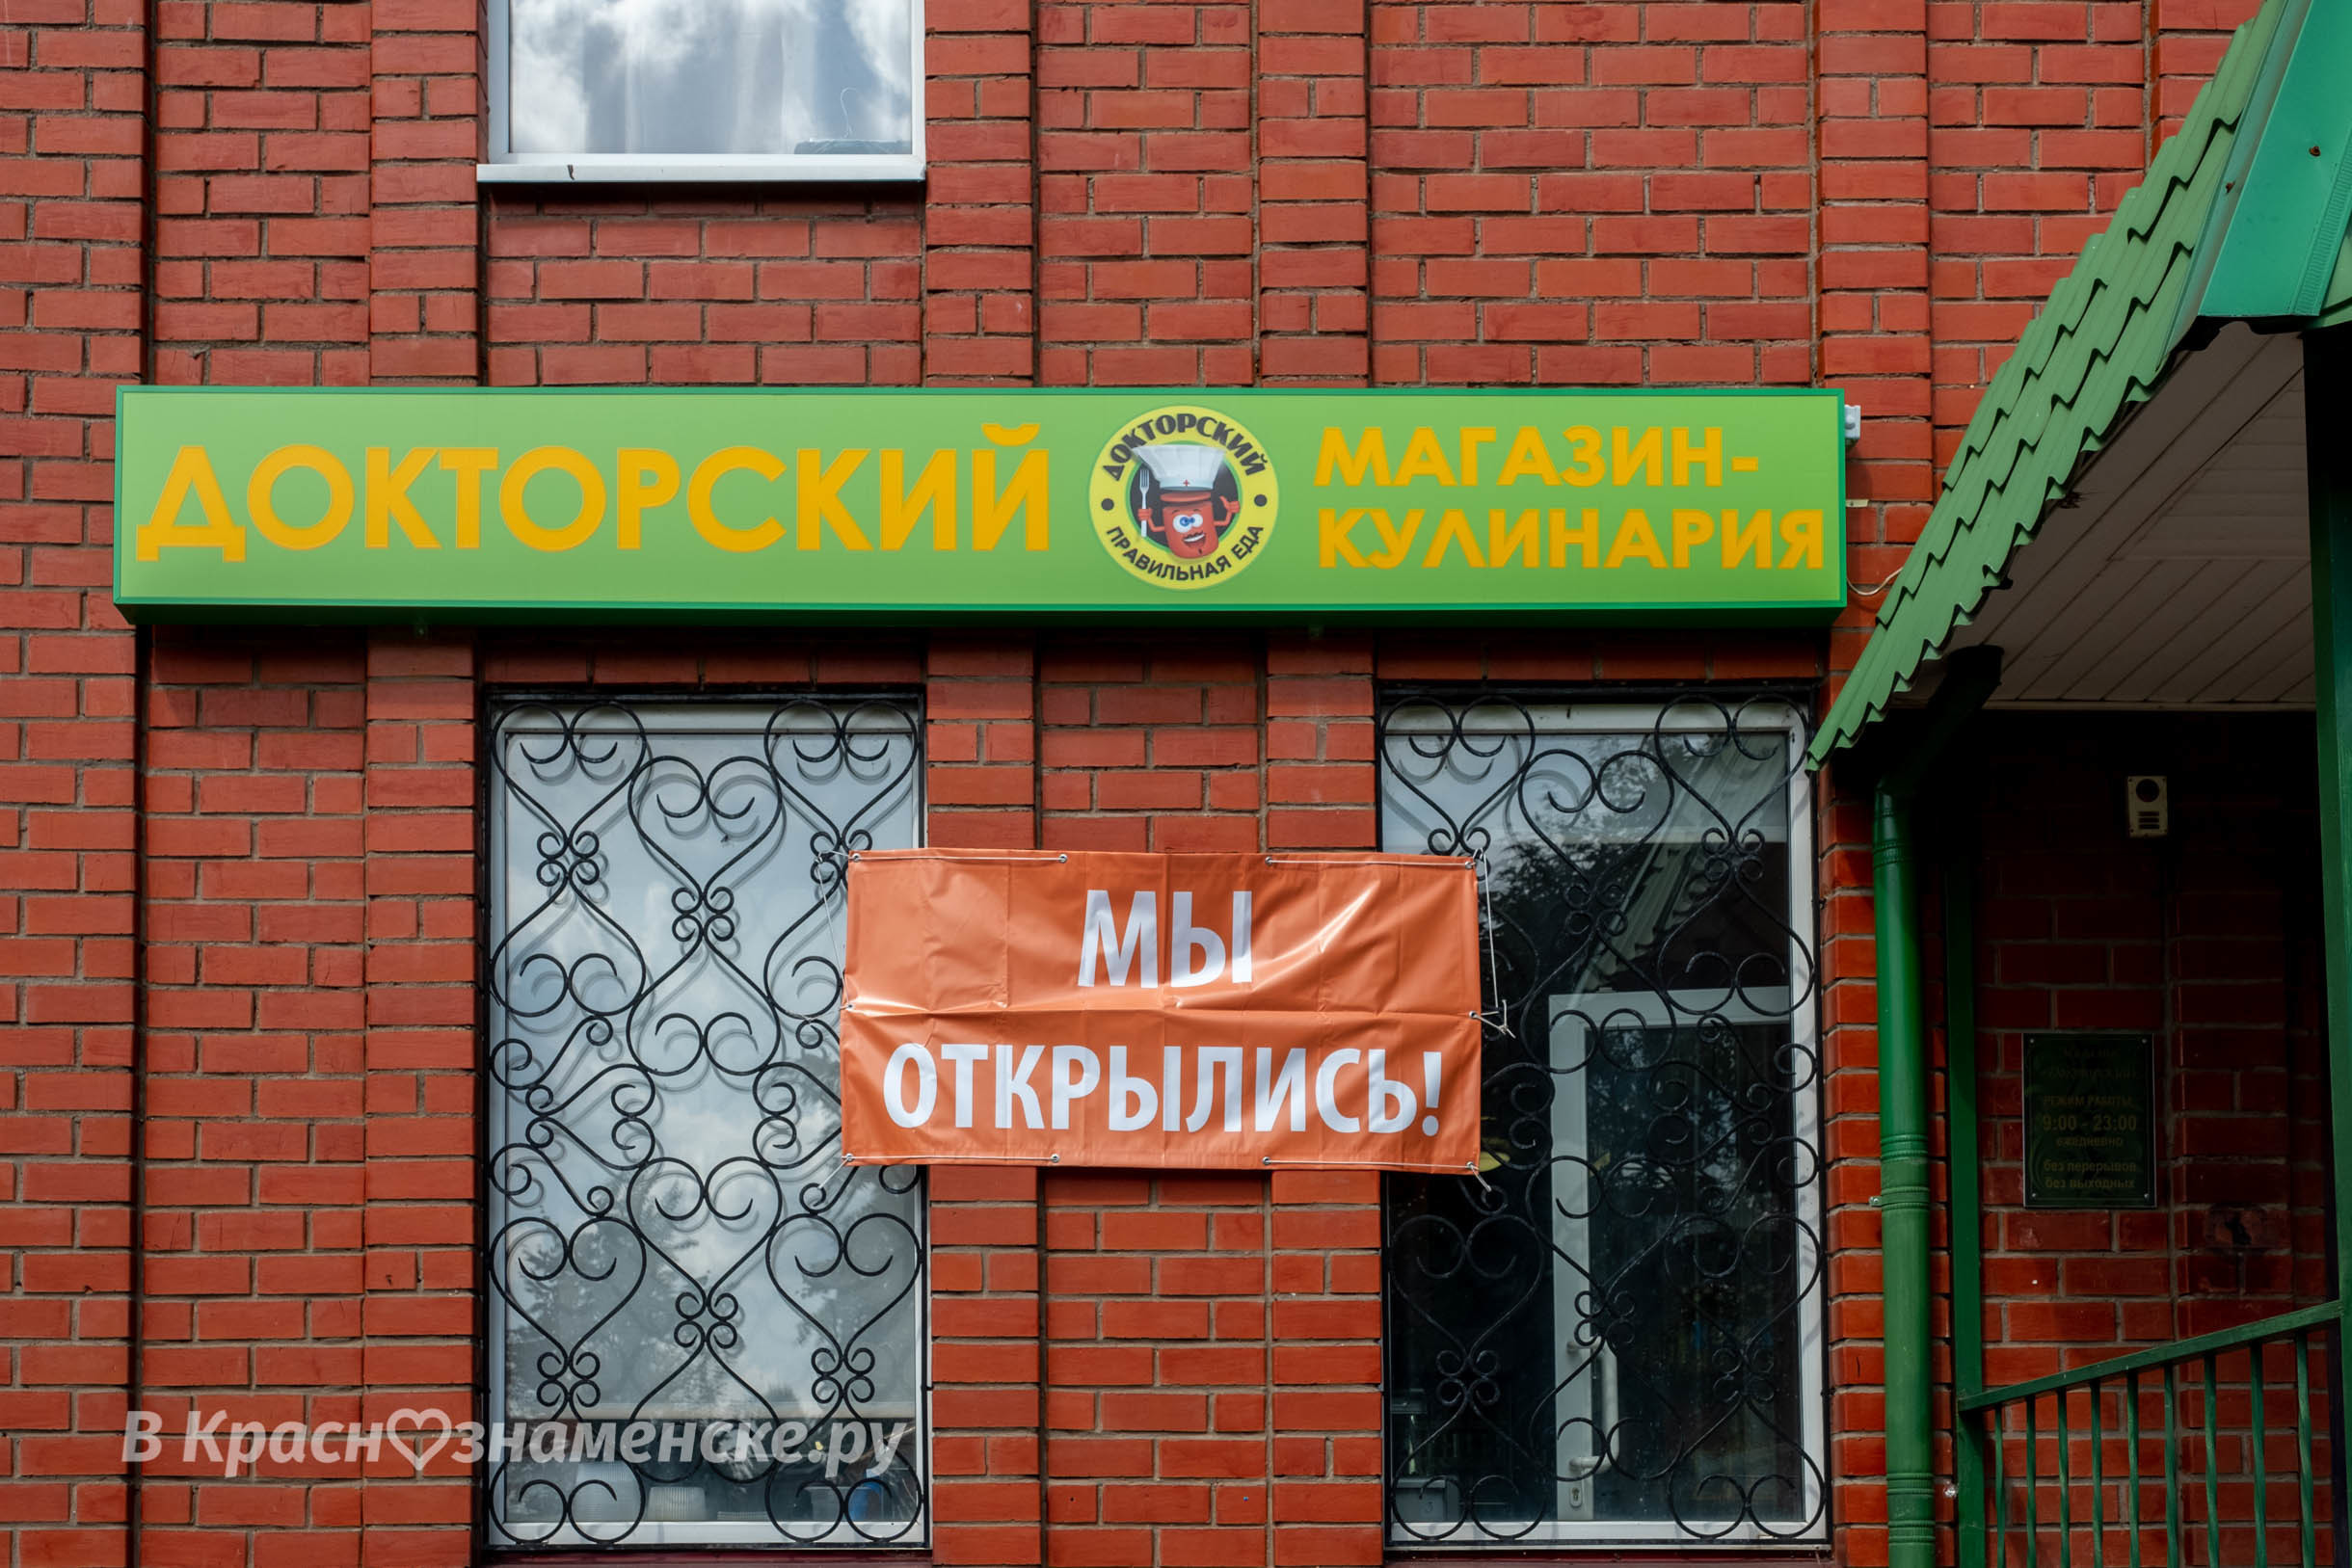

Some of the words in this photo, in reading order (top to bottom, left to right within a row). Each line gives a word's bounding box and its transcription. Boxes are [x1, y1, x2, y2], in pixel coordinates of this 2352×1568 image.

[1102, 412, 1269, 482] ДОКТОРСКИЙ
[1314, 425, 1759, 487] МАГАЗИН-
[136, 421, 1050, 563] ДОКТОРСКИЙ
[1107, 525, 1232, 581] ПРАВИЛЬНАЯ
[1231, 524, 1265, 560] ЕДА
[1318, 508, 1825, 569] КУЛИНАРИЯ
[1077, 890, 1253, 989] МЫ
[882, 1042, 1442, 1136] ОТКРЫЛИСЬ!
[2043, 1114, 2077, 1131] 9:00
[2093, 1114, 2137, 1131] 23:00
[2043, 1159, 2065, 1172] без
[2067, 1162, 2137, 1174] перерывов
[2045, 1177, 2067, 1188] без
[2069, 1178, 2136, 1189] выходных
